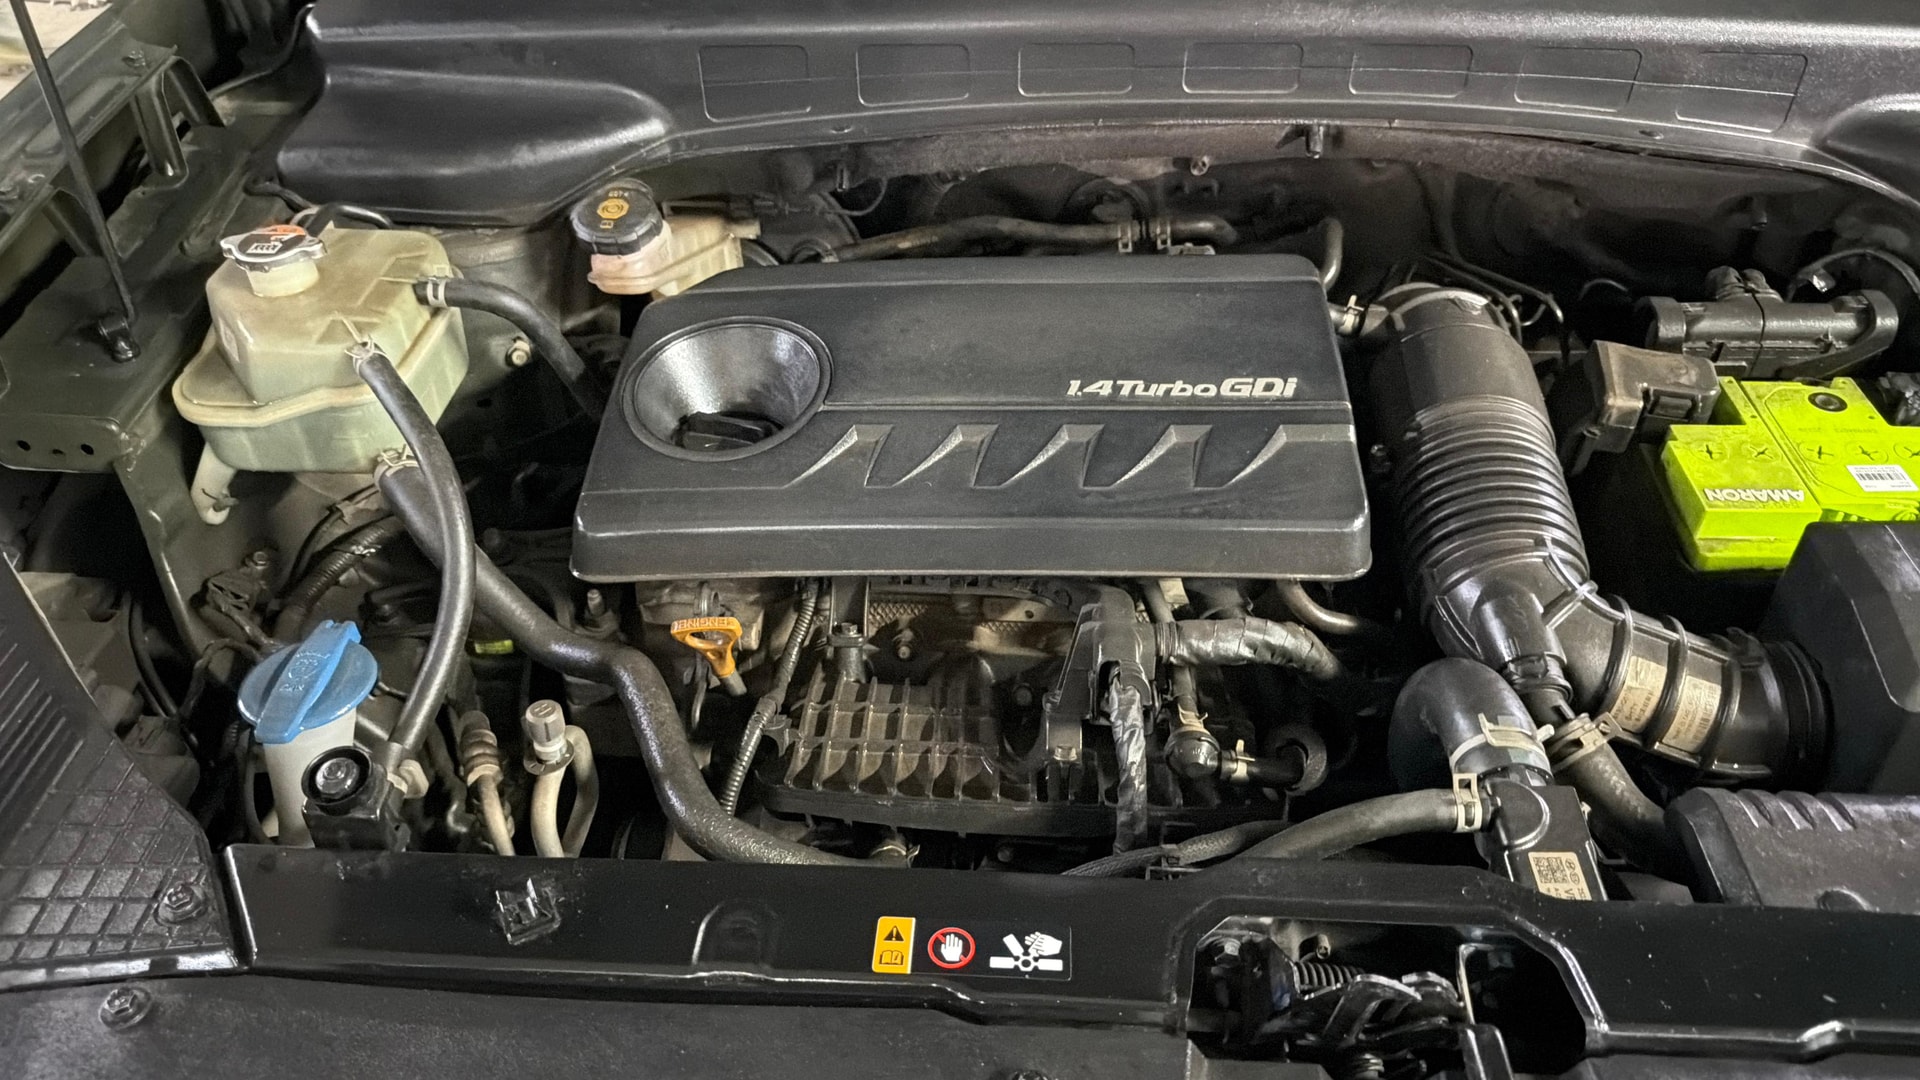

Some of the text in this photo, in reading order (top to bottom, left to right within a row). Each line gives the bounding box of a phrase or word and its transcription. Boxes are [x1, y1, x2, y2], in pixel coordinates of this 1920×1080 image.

[1066, 377, 1298, 397] 1.4 Turbo GDi
[1703, 488, 1805, 502] AMARON
[679, 617, 728, 629] ENGINE
